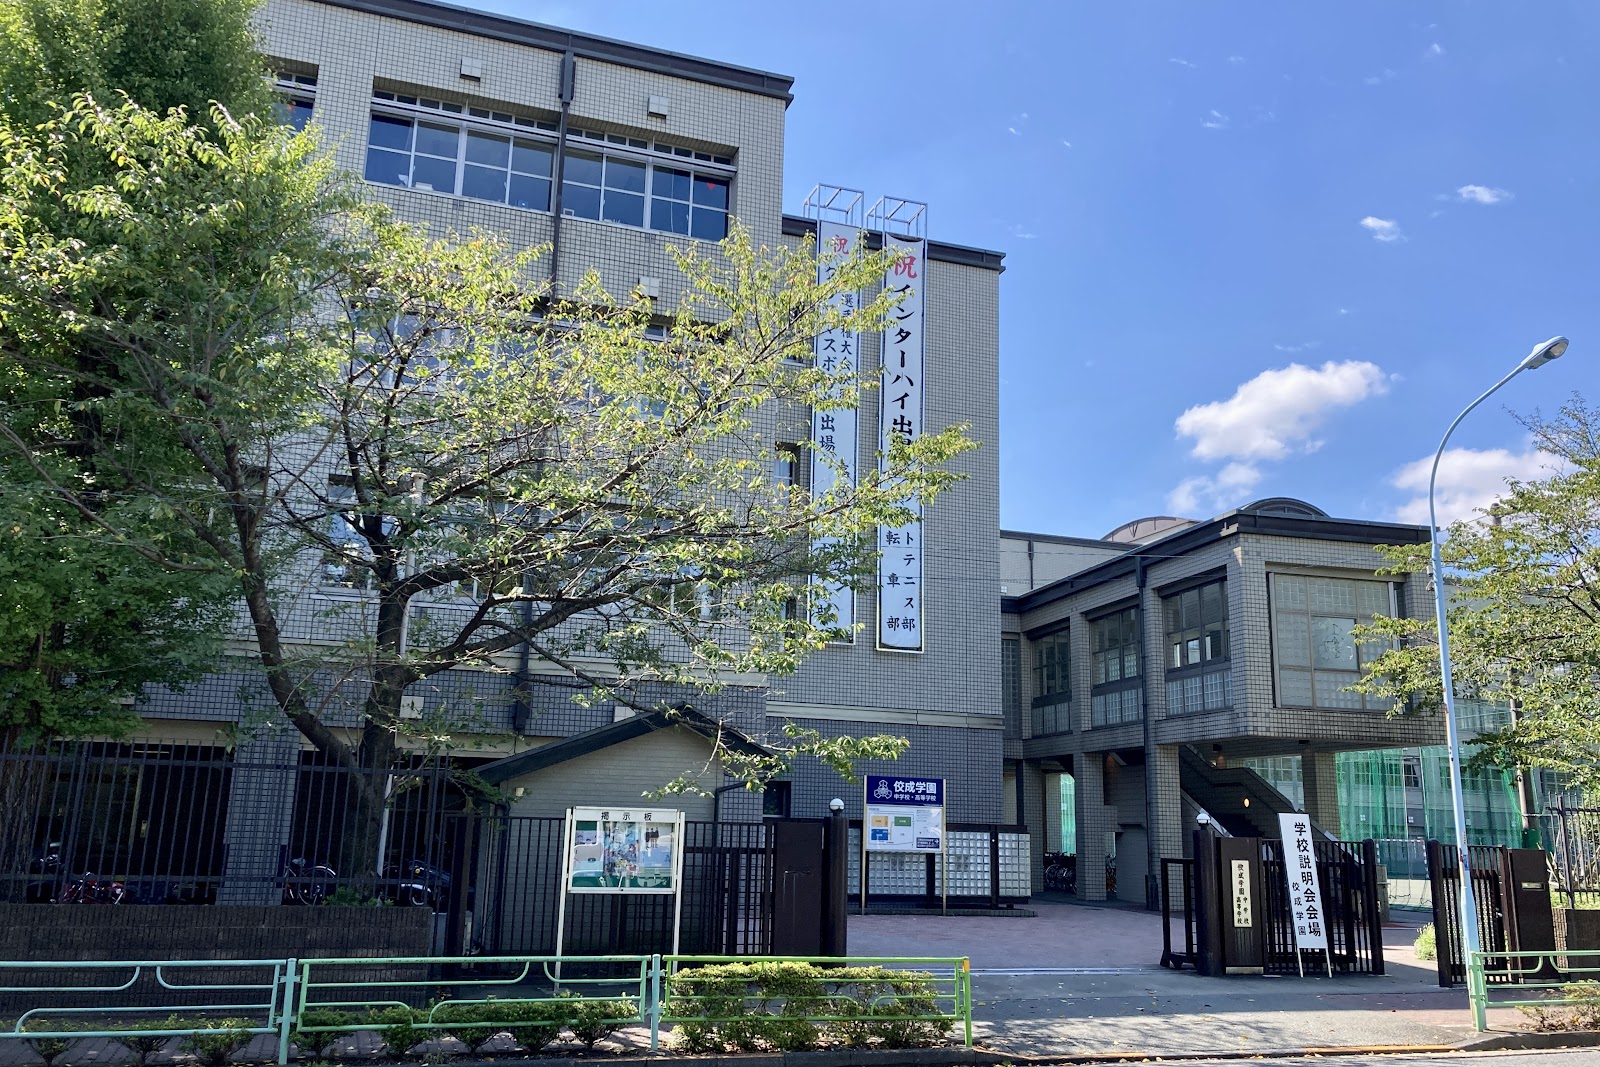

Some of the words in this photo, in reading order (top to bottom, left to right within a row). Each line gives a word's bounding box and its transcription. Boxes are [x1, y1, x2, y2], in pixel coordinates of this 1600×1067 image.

[885, 530, 901, 632] 転車部
[600, 811, 653, 821] 掲示板
[893, 780, 937, 794] 佼成学園
[1294, 822, 1321, 937] 学校説明会会場
